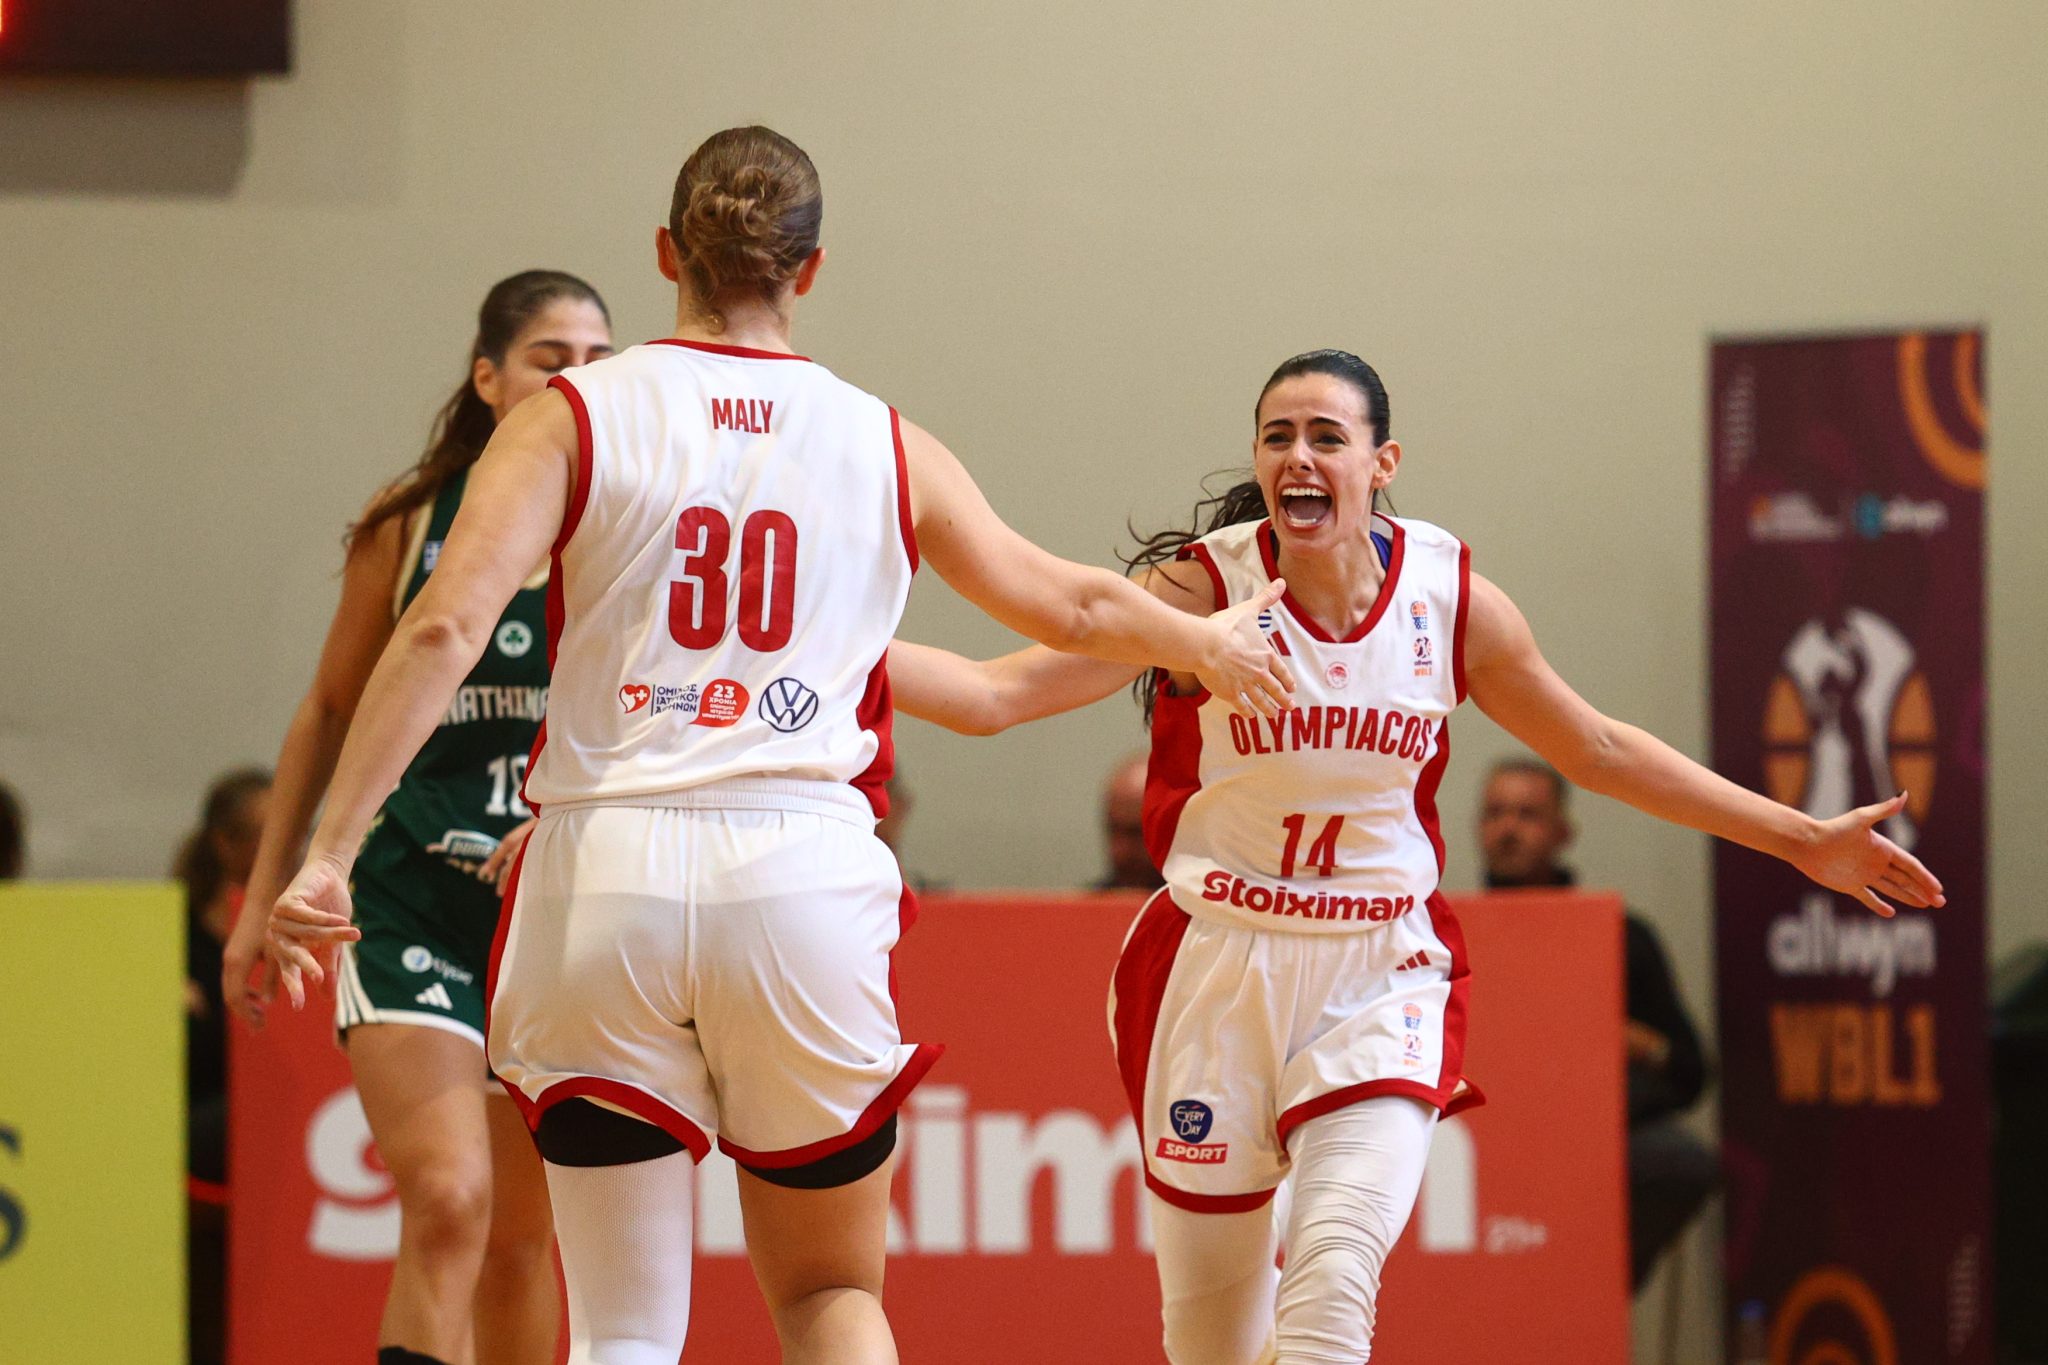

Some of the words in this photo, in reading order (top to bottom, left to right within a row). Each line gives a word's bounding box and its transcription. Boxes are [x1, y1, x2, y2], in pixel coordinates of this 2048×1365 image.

[711, 398, 774, 434] MALY
[668, 505, 798, 653] 30
[713, 683, 735, 699] 23
[1229, 706, 1432, 763] OLYMPIACOS
[1281, 813, 1345, 878] 14
[1202, 870, 1415, 922] Stoiximan
[1164, 1142, 1226, 1161] SPORT
